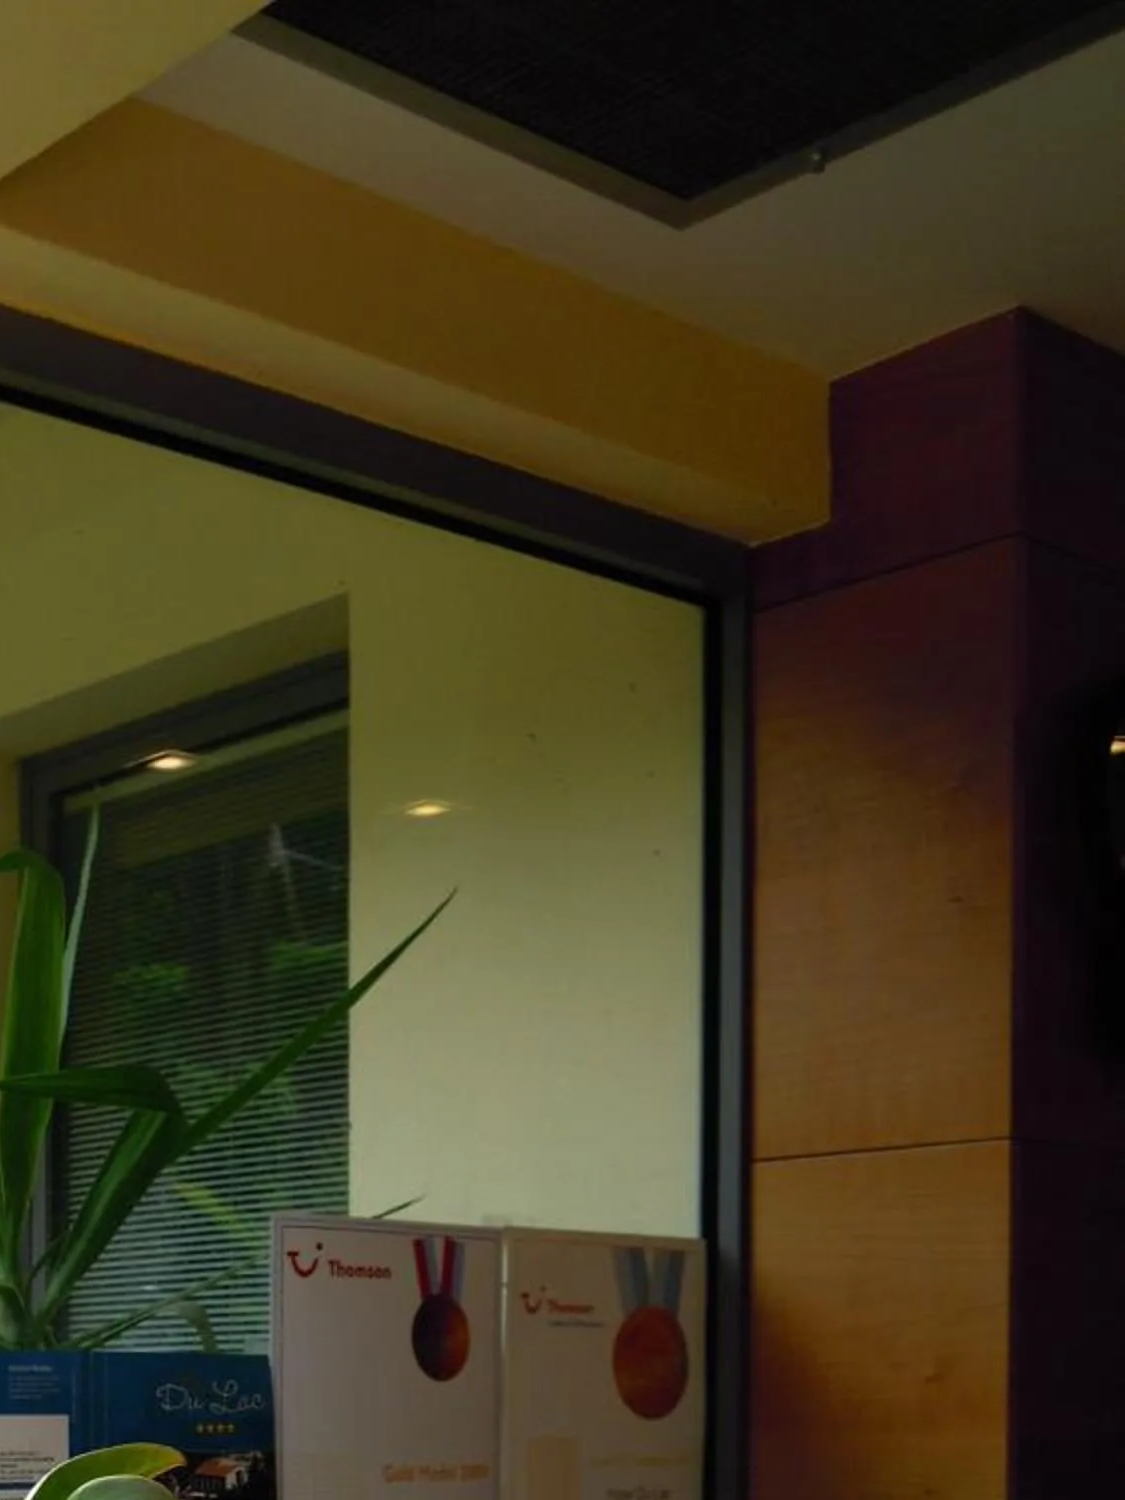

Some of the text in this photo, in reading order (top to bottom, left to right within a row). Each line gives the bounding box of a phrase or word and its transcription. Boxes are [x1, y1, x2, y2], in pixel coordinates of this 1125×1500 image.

[328, 1259, 392, 1280] Thomson
[155, 1379, 266, 1415] Du Lac
